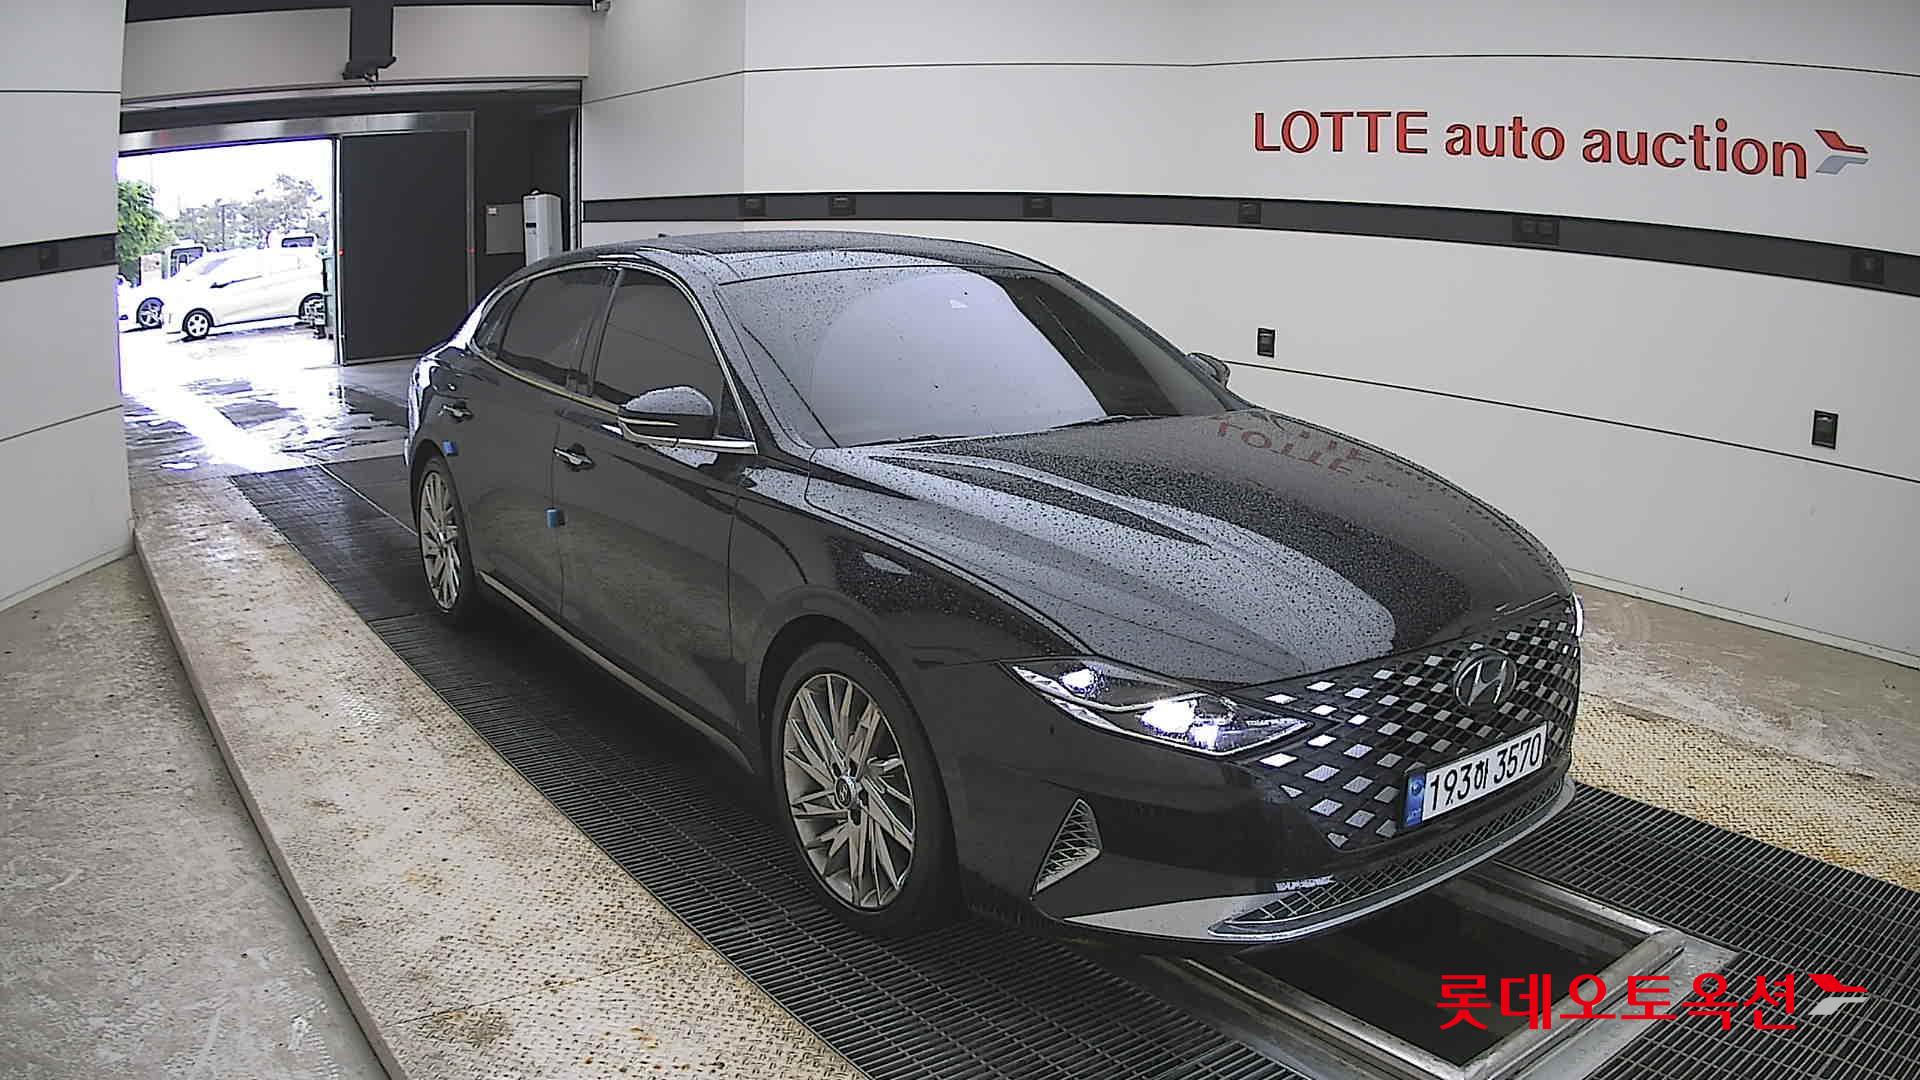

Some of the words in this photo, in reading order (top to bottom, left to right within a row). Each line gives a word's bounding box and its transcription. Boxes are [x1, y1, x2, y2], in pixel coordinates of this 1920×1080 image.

[1254, 110, 1428, 154] LOTTE
[1444, 116, 1566, 161] auto
[1582, 118, 1808, 179] auction
[1430, 758, 1489, 811] 193하
[1493, 732, 1542, 784] 3570
